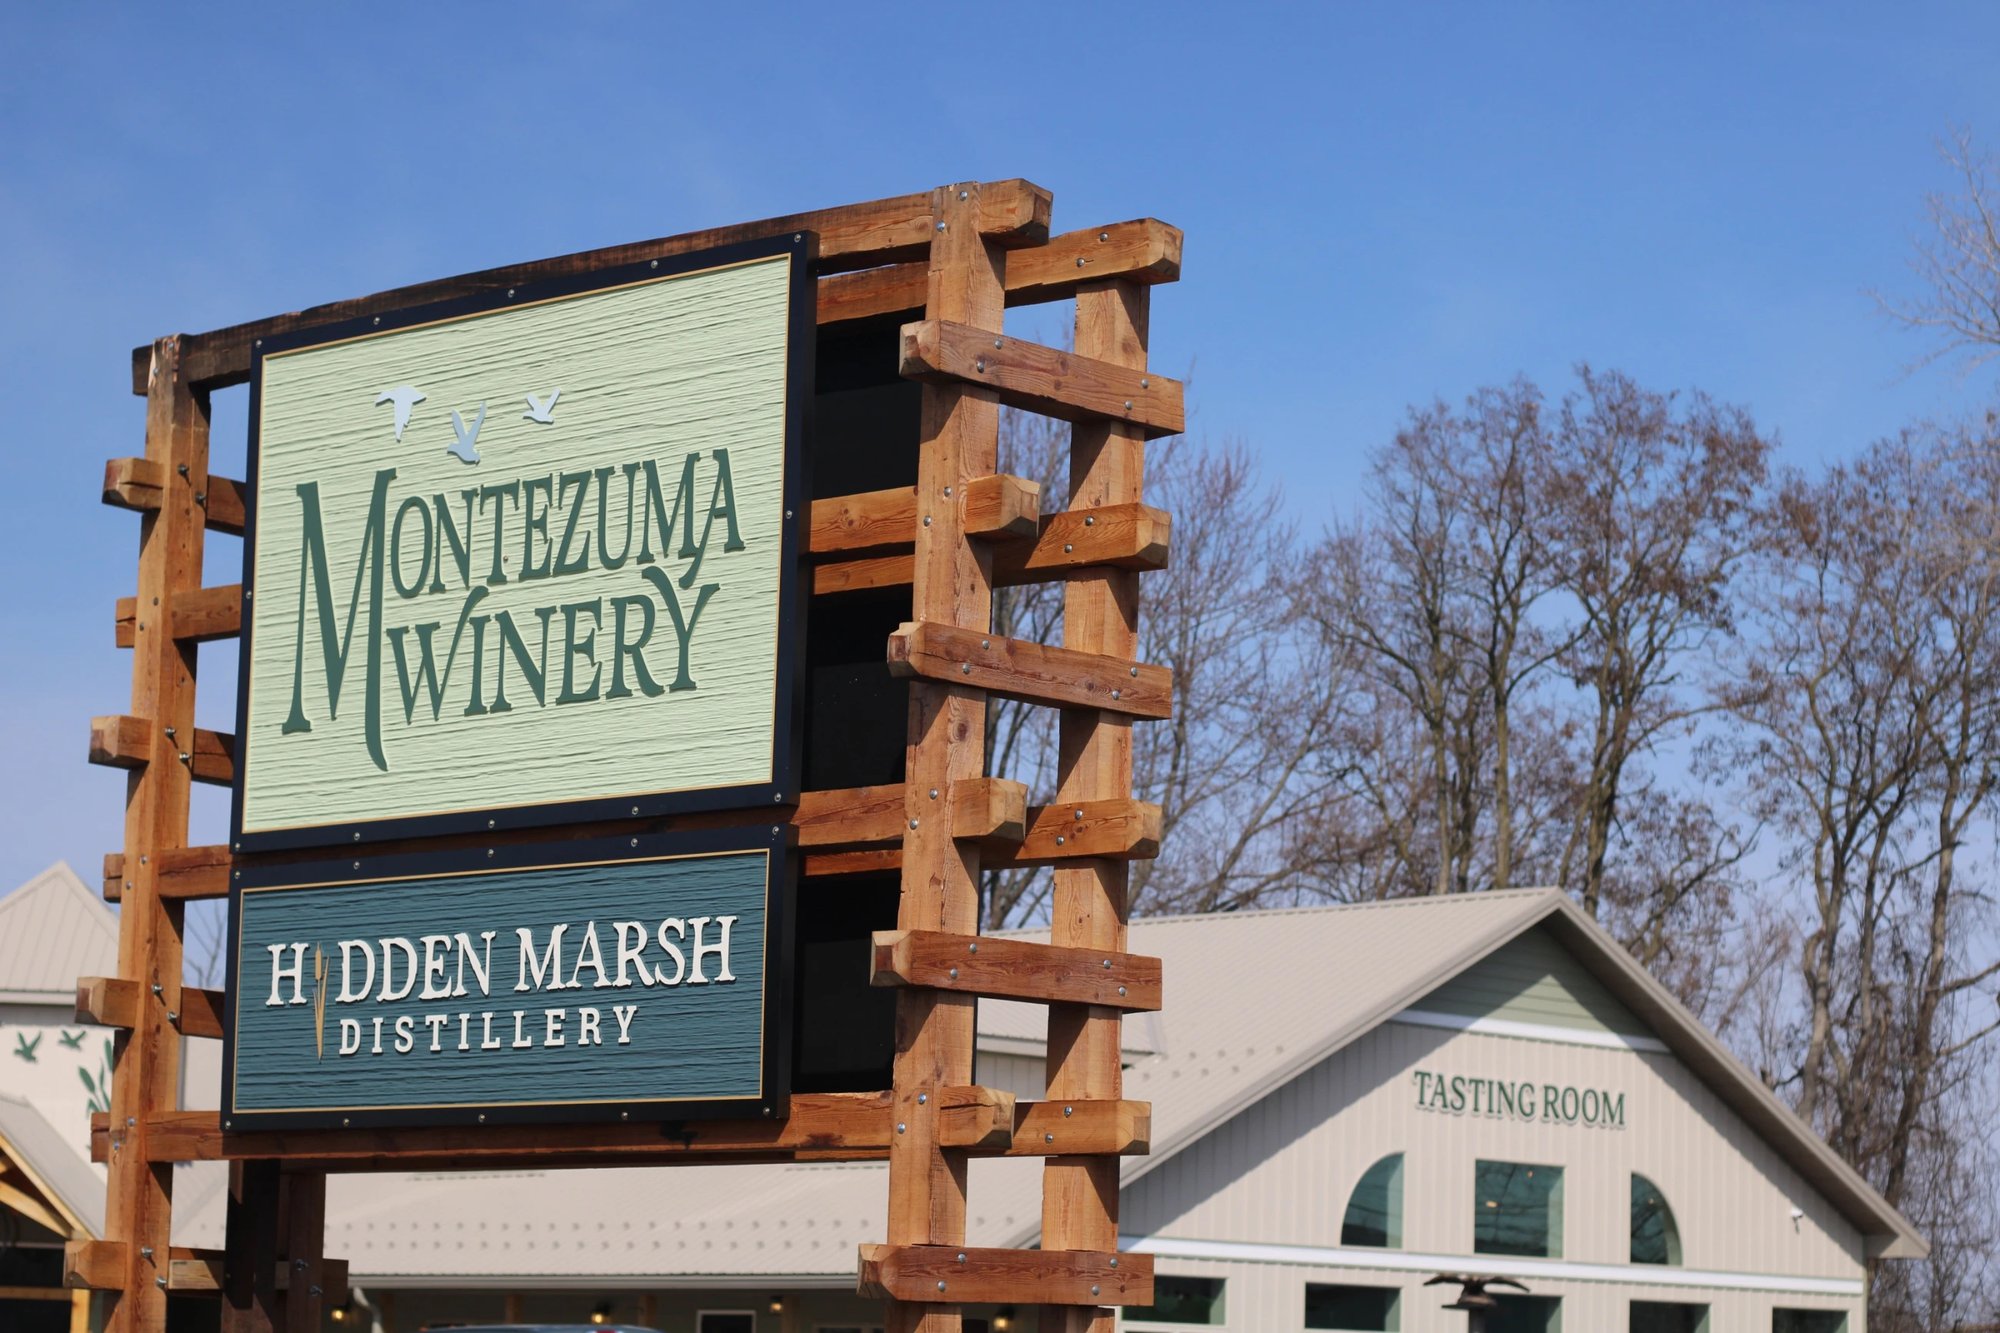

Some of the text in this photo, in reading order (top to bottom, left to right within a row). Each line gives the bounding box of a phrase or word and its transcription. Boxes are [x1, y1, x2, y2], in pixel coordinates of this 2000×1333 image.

[282, 448, 746, 772] MONTEZUMA
[386, 566, 721, 726] WINERY
[513, 915, 739, 992] MARSH
[338, 1005, 638, 1056] DISTILLERY
[1414, 1070, 1626, 1126] TASTING ROOM
